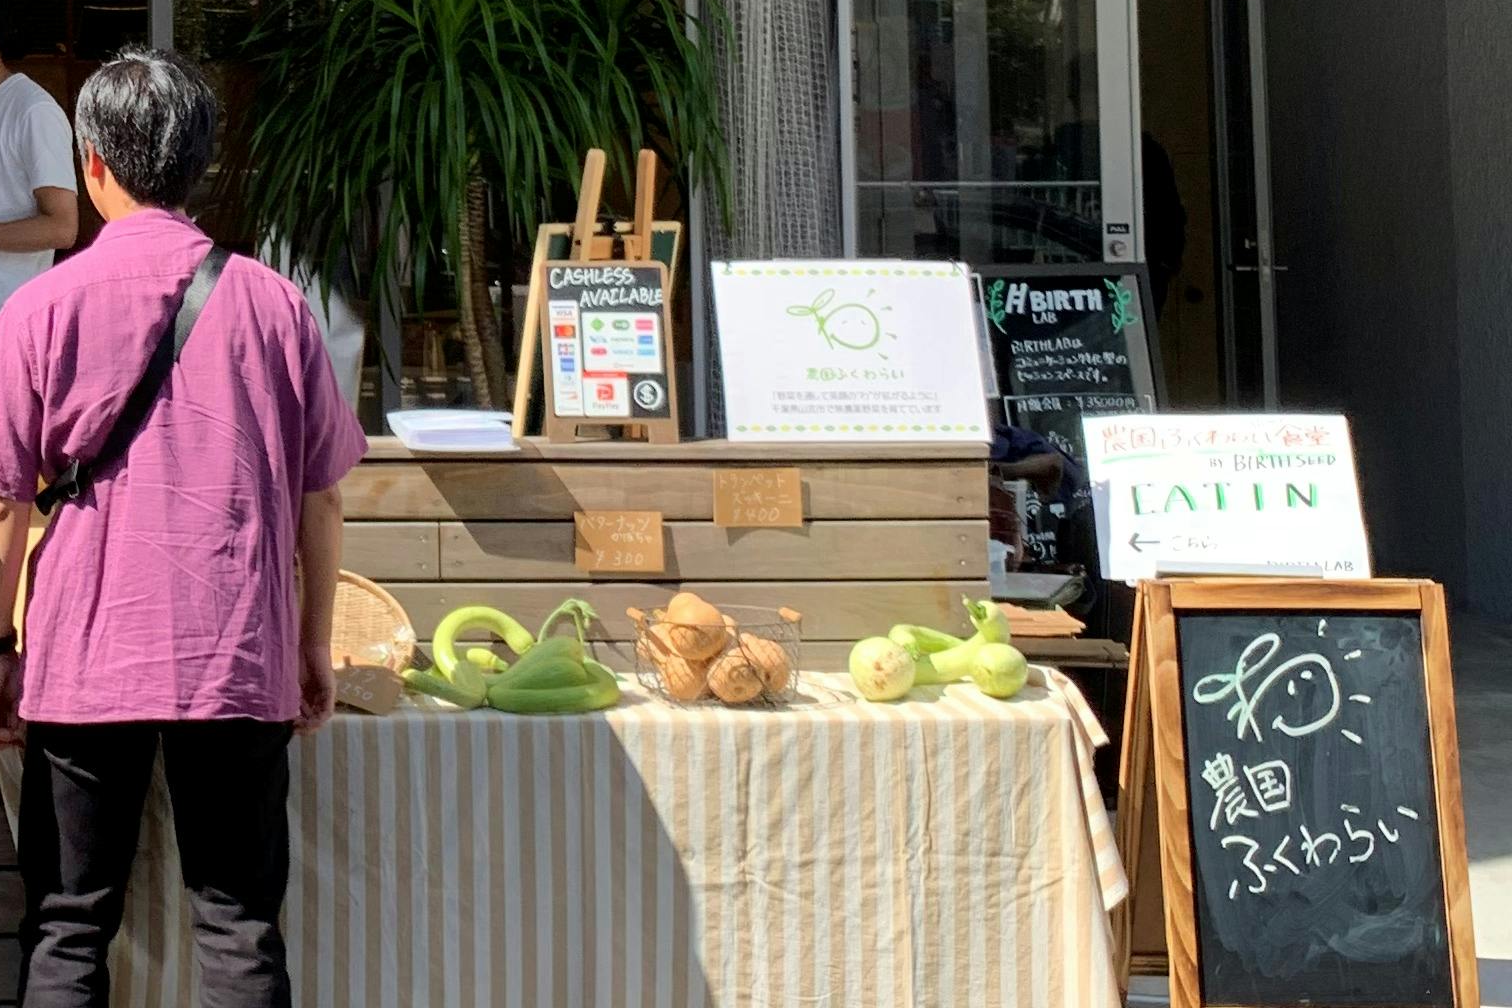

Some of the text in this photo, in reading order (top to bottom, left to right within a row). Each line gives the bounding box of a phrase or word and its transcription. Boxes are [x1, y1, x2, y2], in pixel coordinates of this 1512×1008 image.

[550, 267, 635, 289] CASHLESS
[579, 286, 663, 309] AVAILABLE
[1029, 288, 1104, 313] BIRTH
[1031, 312, 1058, 325] LAB
[1209, 457, 1223, 469] BY
[1324, 560, 1355, 572] LAB
[1220, 803, 1419, 900] ふくわらい
